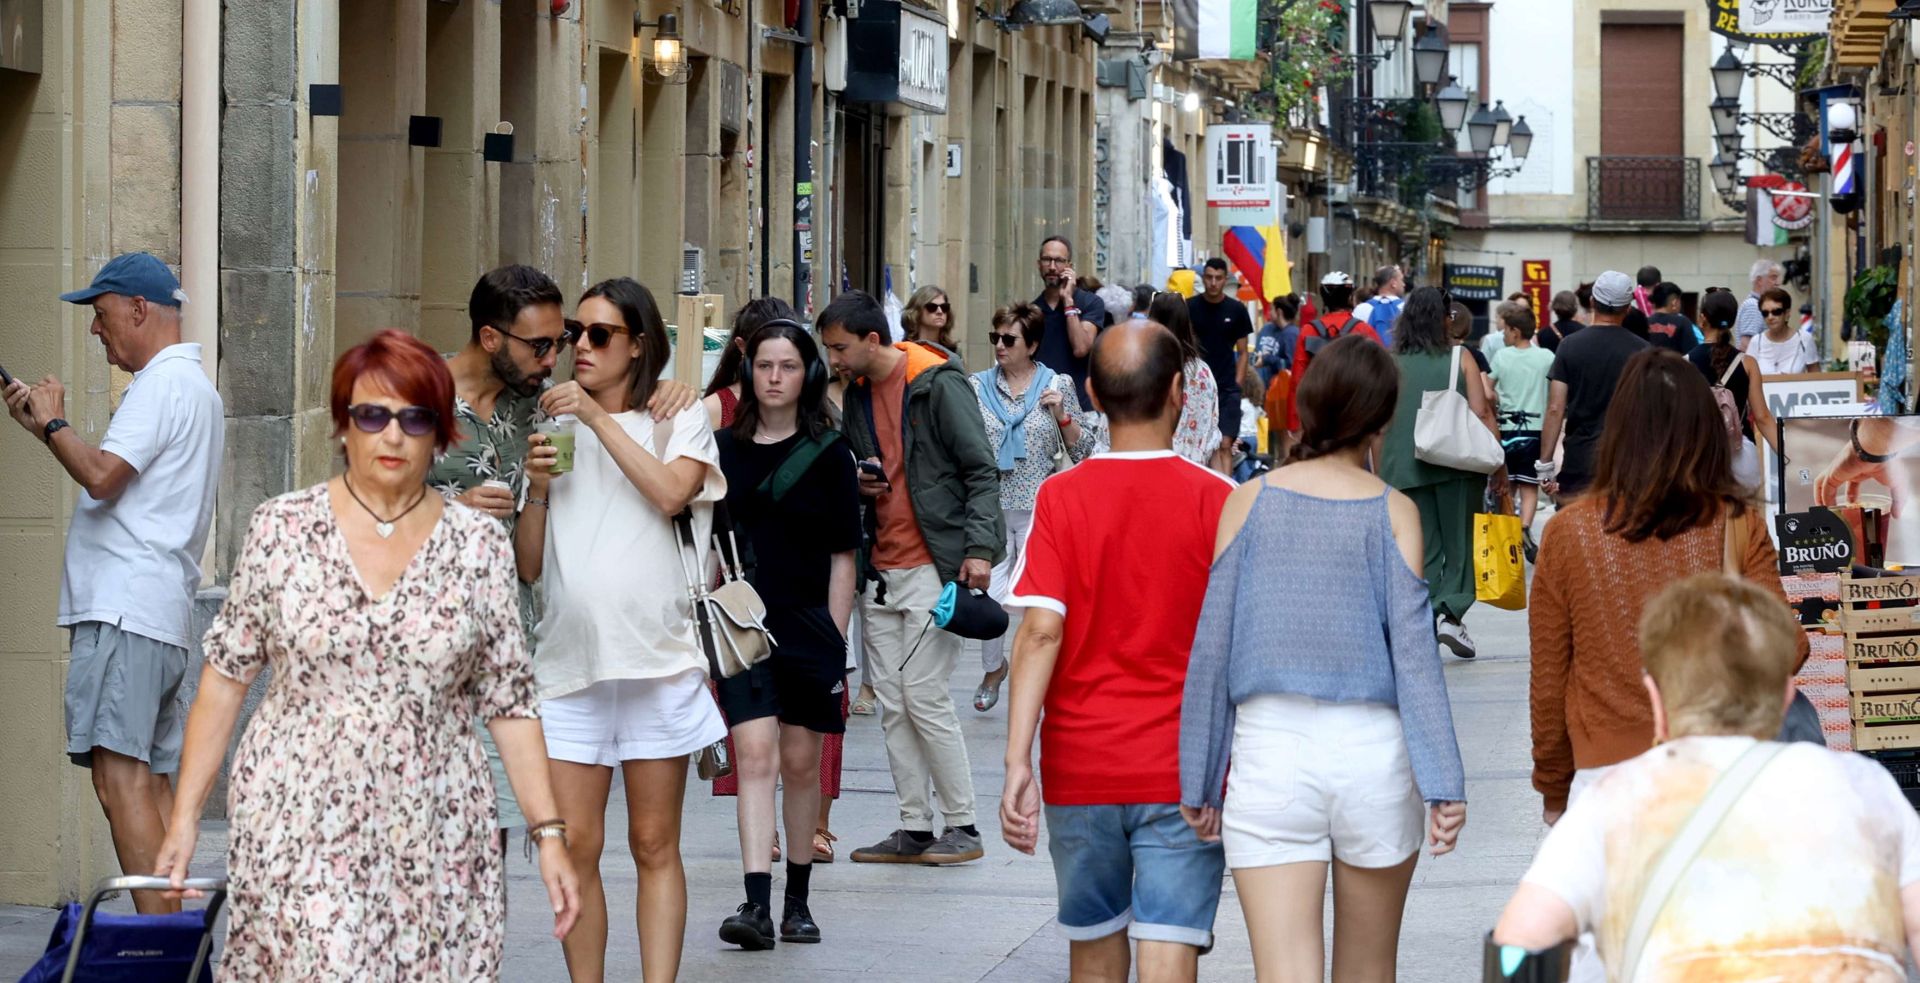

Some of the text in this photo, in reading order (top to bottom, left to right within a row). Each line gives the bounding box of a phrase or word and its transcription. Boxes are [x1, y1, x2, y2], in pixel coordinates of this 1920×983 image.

[1785, 539, 1850, 563] BRUÑÓ
[1849, 579, 1914, 600] BRUÑÓ
[1853, 638, 1919, 659] BRUÑÓ
